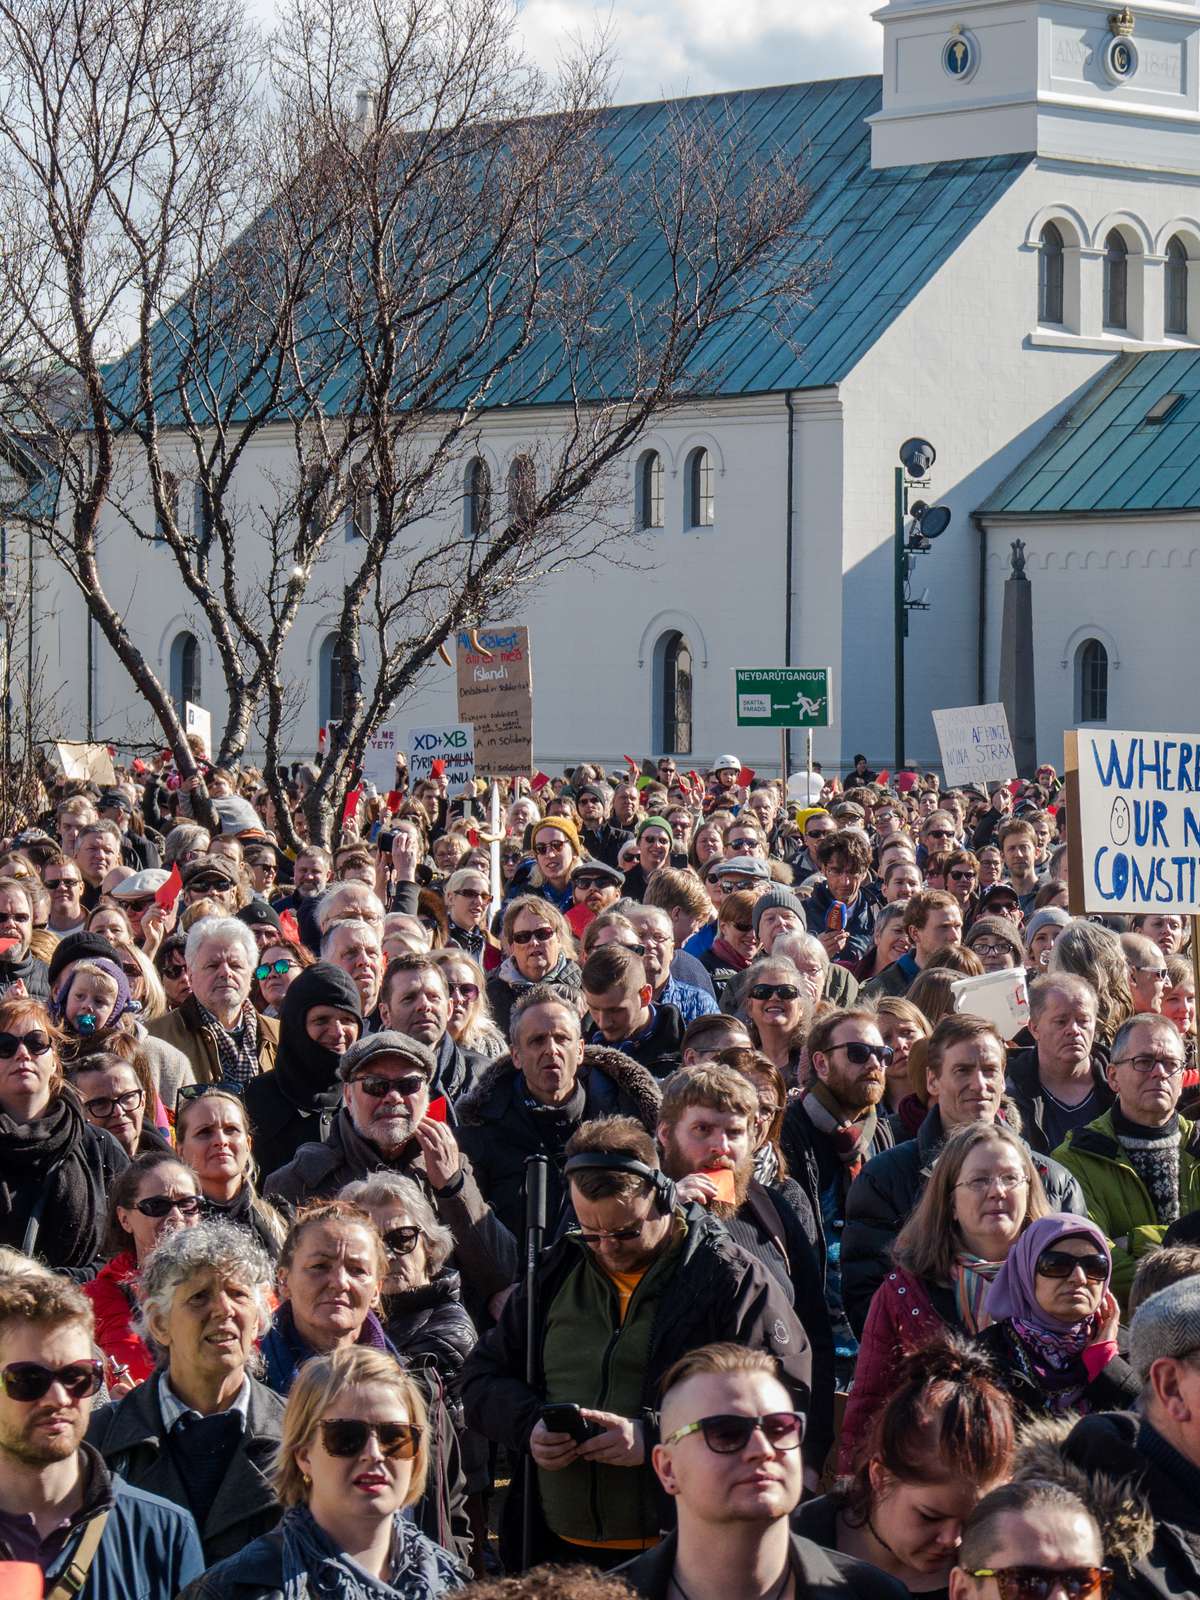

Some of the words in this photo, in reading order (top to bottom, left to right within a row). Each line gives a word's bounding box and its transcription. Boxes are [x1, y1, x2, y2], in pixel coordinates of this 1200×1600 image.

[738, 669, 825, 681] NEYÐARÚTGANGUR
[382, 731, 394, 739] ME
[414, 730, 468, 751] XD+XB
[371, 741, 395, 750] YET?
[975, 742, 1014, 763] STRAX
[1110, 795, 1170, 848] OUR
